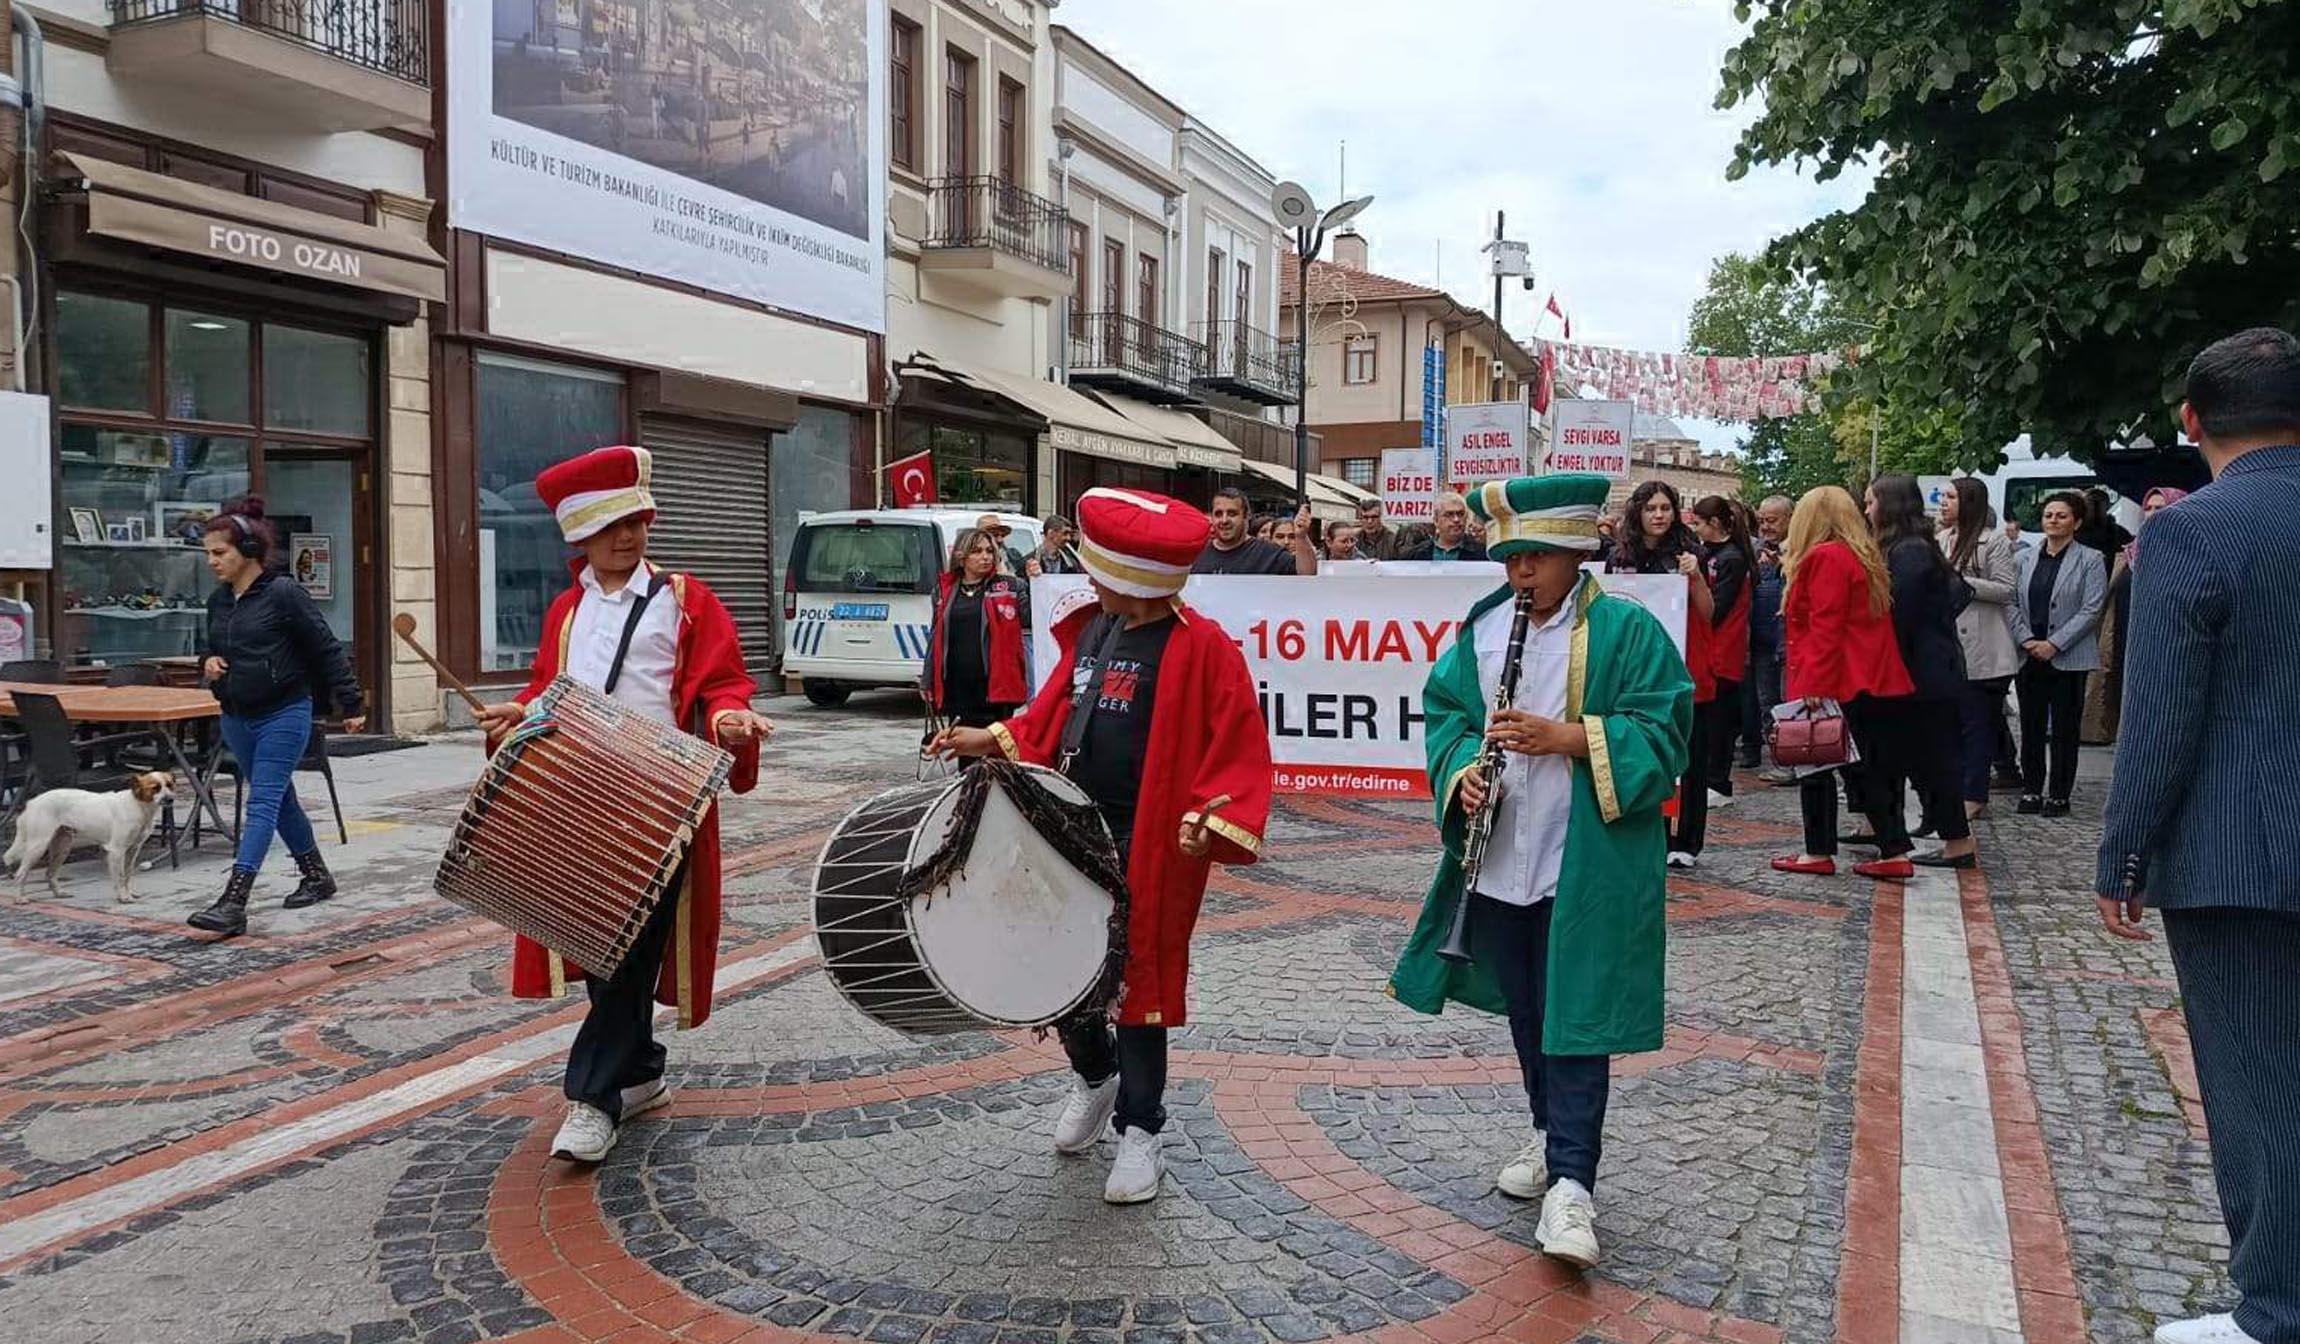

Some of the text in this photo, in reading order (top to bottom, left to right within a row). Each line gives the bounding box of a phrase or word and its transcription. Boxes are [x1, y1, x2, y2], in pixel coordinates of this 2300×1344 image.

[491, 139, 537, 171] KÜLTÜR
[541, 153, 556, 176] VE
[560, 160, 600, 190] TURİZM
[603, 173, 658, 207] BAKANLIĞI
[209, 225, 361, 278] FOTO OZAN
[1462, 431, 1512, 450] ASIL ENGEL
[1564, 425, 1621, 446] SEVGİ VARSA
[1557, 454, 1624, 472] ENGEL YOKTUR
[1387, 472, 1433, 492] BİZ DE
[1385, 501, 1433, 516] VARIZ!
[1324, 619, 1468, 662] MAY
[1272, 770, 1410, 791] le.gov.tr/edirne
